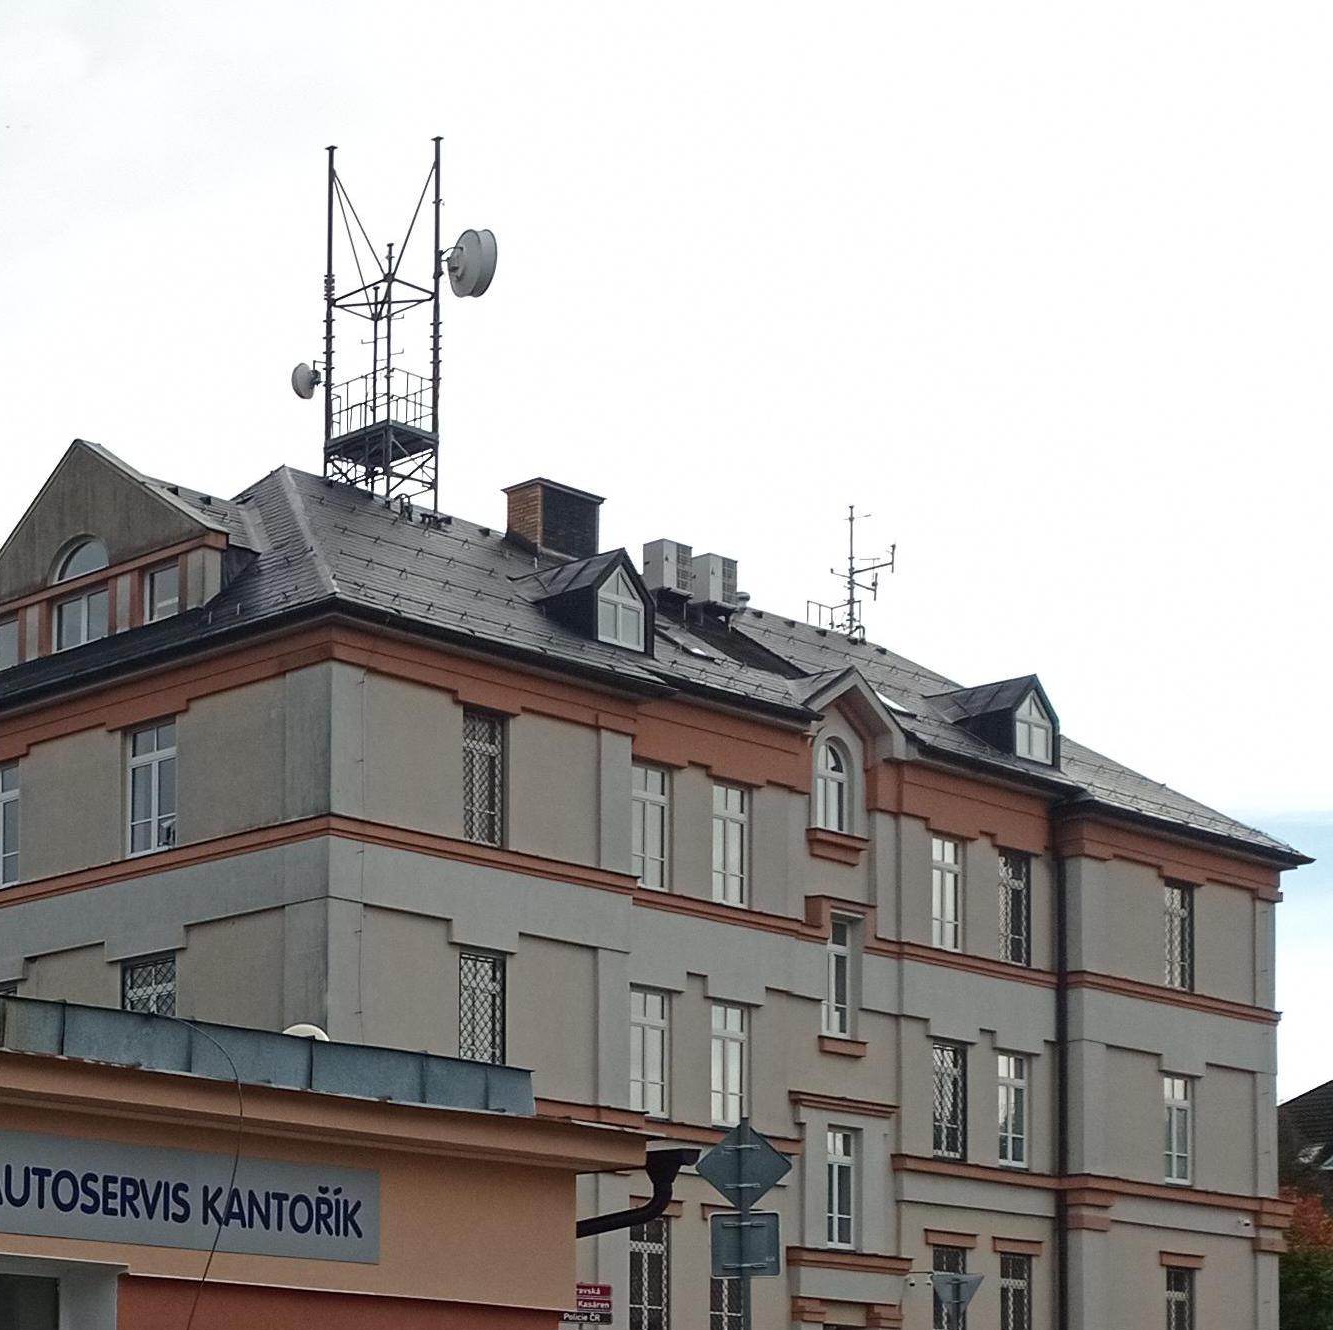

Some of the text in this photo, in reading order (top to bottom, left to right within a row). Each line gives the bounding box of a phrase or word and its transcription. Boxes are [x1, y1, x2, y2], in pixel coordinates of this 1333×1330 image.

[202, 1185, 364, 1240] KANTOŘÍK
[563, 1311, 601, 1322] Policie ČR
